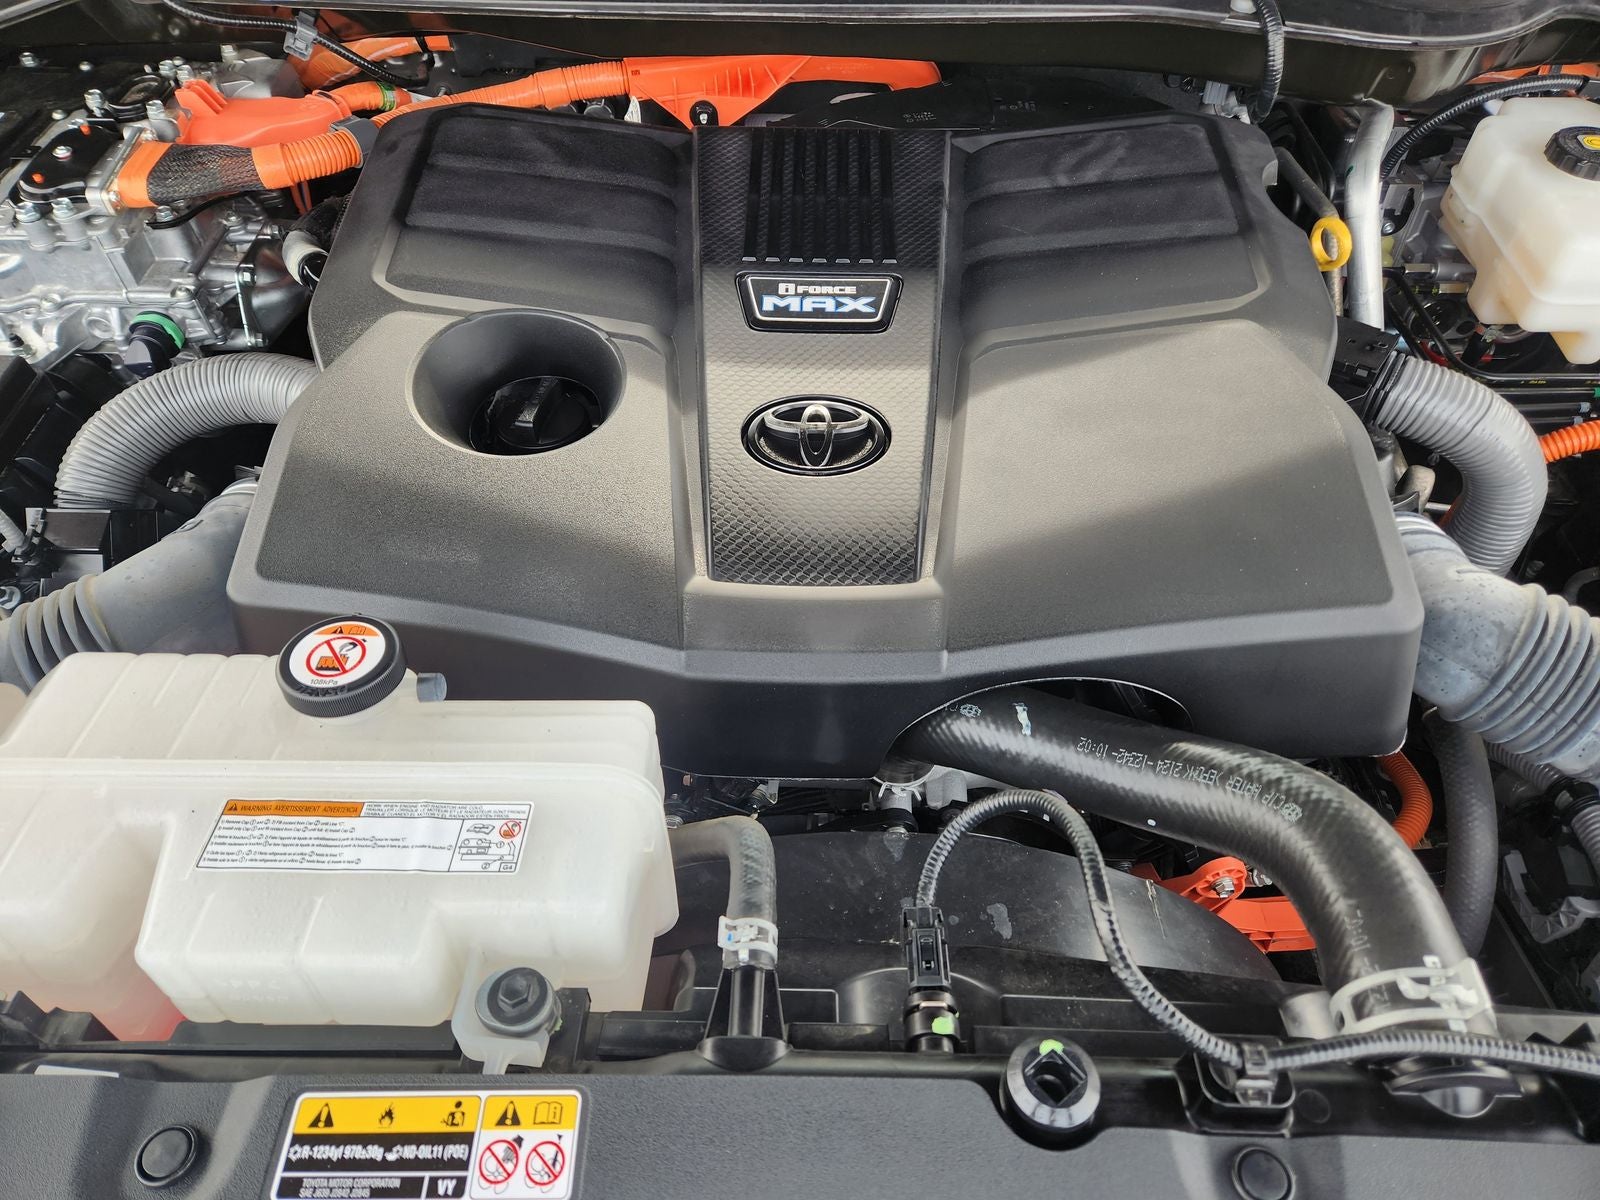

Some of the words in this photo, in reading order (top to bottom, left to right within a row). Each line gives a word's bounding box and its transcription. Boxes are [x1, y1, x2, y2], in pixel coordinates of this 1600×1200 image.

[797, 285, 857, 294] FORCE
[762, 294, 876, 313] MAX
[1076, 736, 1108, 760] 10:02
[1155, 758, 1184, 777] 2124
[240, 804, 272, 812] WARNING
[274, 804, 320, 813] AVERTISSEMENT
[323, 805, 358, 813] ADVERTENCIA
[301, 1144, 344, 1161] R-1234yf
[402, 1144, 443, 1160] ND-OIL11
[443, 1144, 469, 1161] (POE)
[302, 1177, 328, 1188] TOYOTA
[328, 1177, 352, 1188] MOTOR
[353, 1177, 401, 1189] CORPORATION
[437, 1178, 458, 1196] VY
[299, 1187, 314, 1198] SAE
